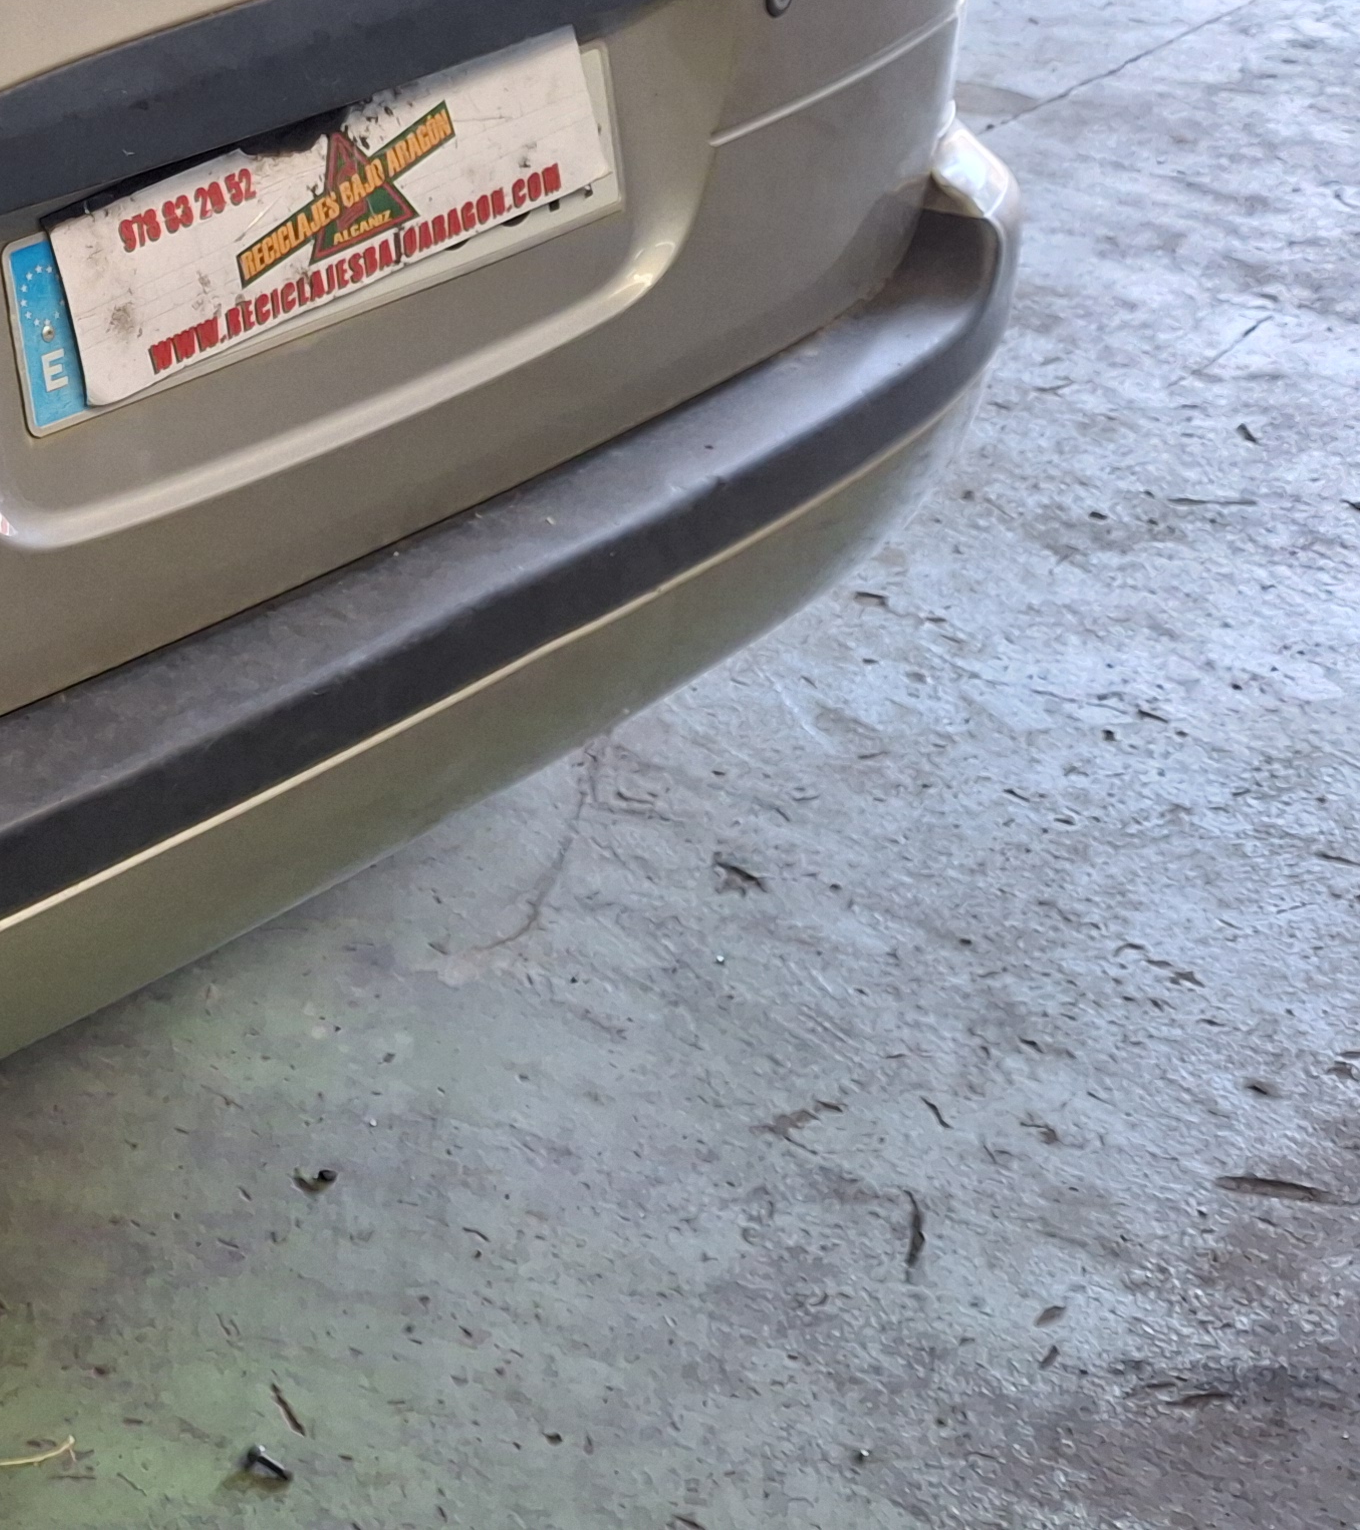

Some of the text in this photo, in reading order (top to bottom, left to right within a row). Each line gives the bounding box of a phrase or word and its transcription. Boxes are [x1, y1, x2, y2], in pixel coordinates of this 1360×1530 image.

[118, 168, 257, 253] 978 83 20 52
[239, 108, 453, 281] RECICLAJES BAJO ARAGÓN
[40, 348, 69, 393] E
